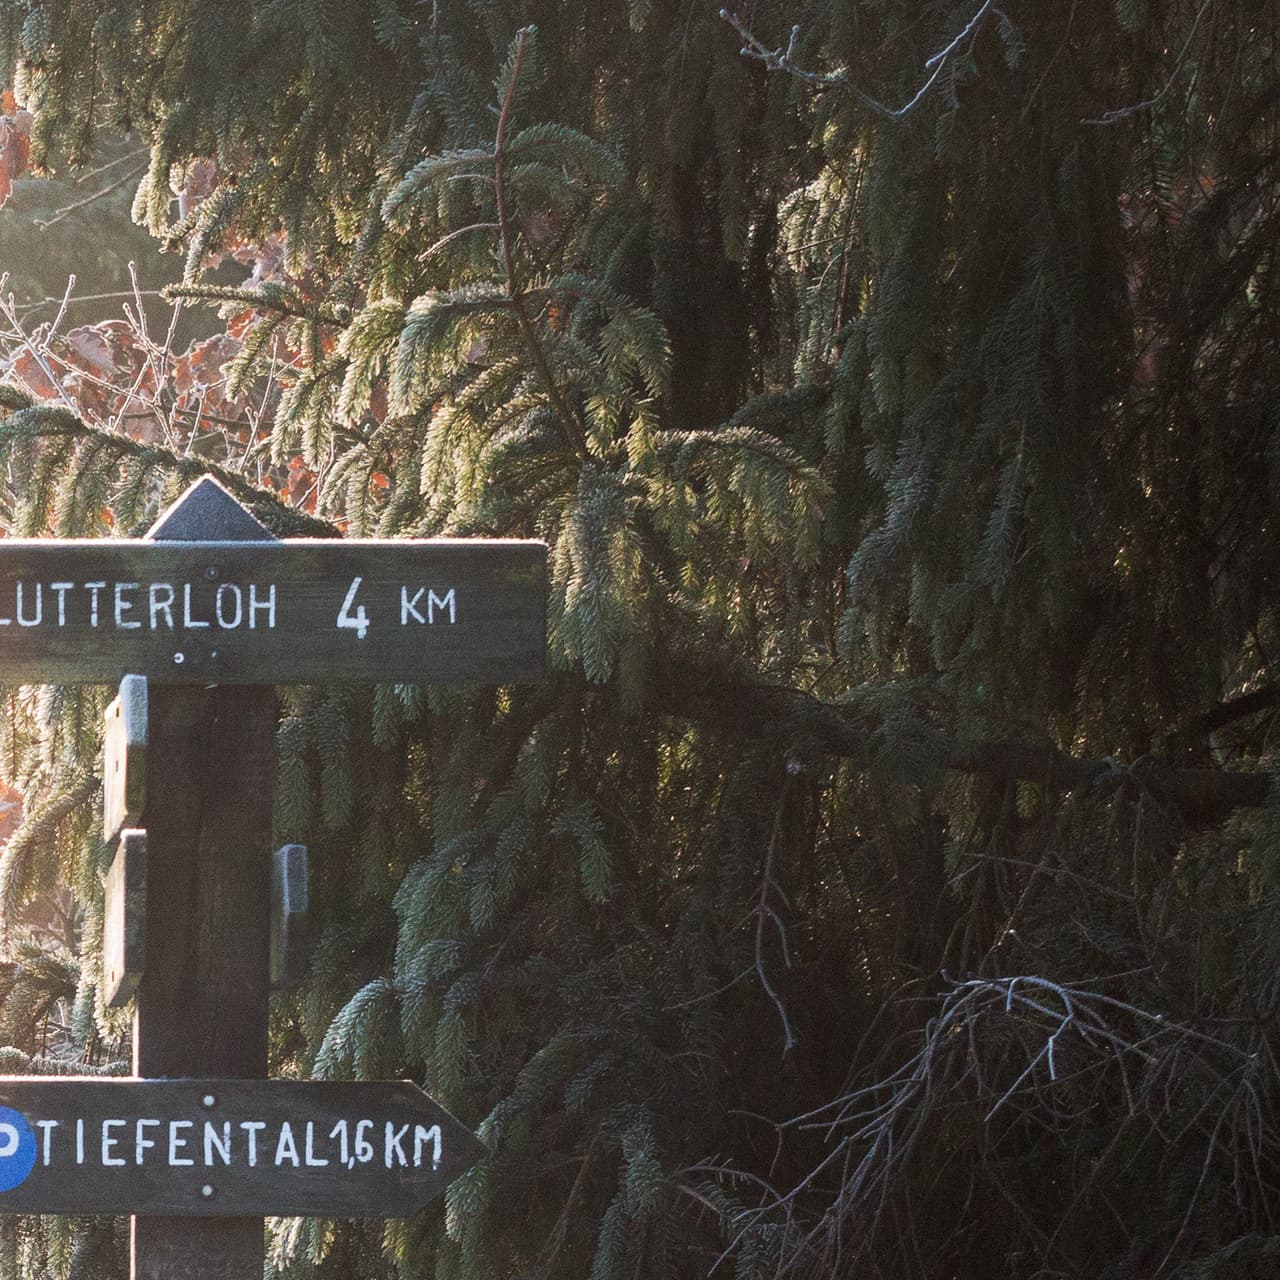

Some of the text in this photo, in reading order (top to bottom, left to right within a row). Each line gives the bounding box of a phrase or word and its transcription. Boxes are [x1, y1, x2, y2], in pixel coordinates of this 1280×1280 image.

[336, 576, 370, 639] 4
[400, 585, 456, 626] KM
[36, 1118, 329, 1168] TIEFENTAL
[384, 1121, 442, 1170] KM
